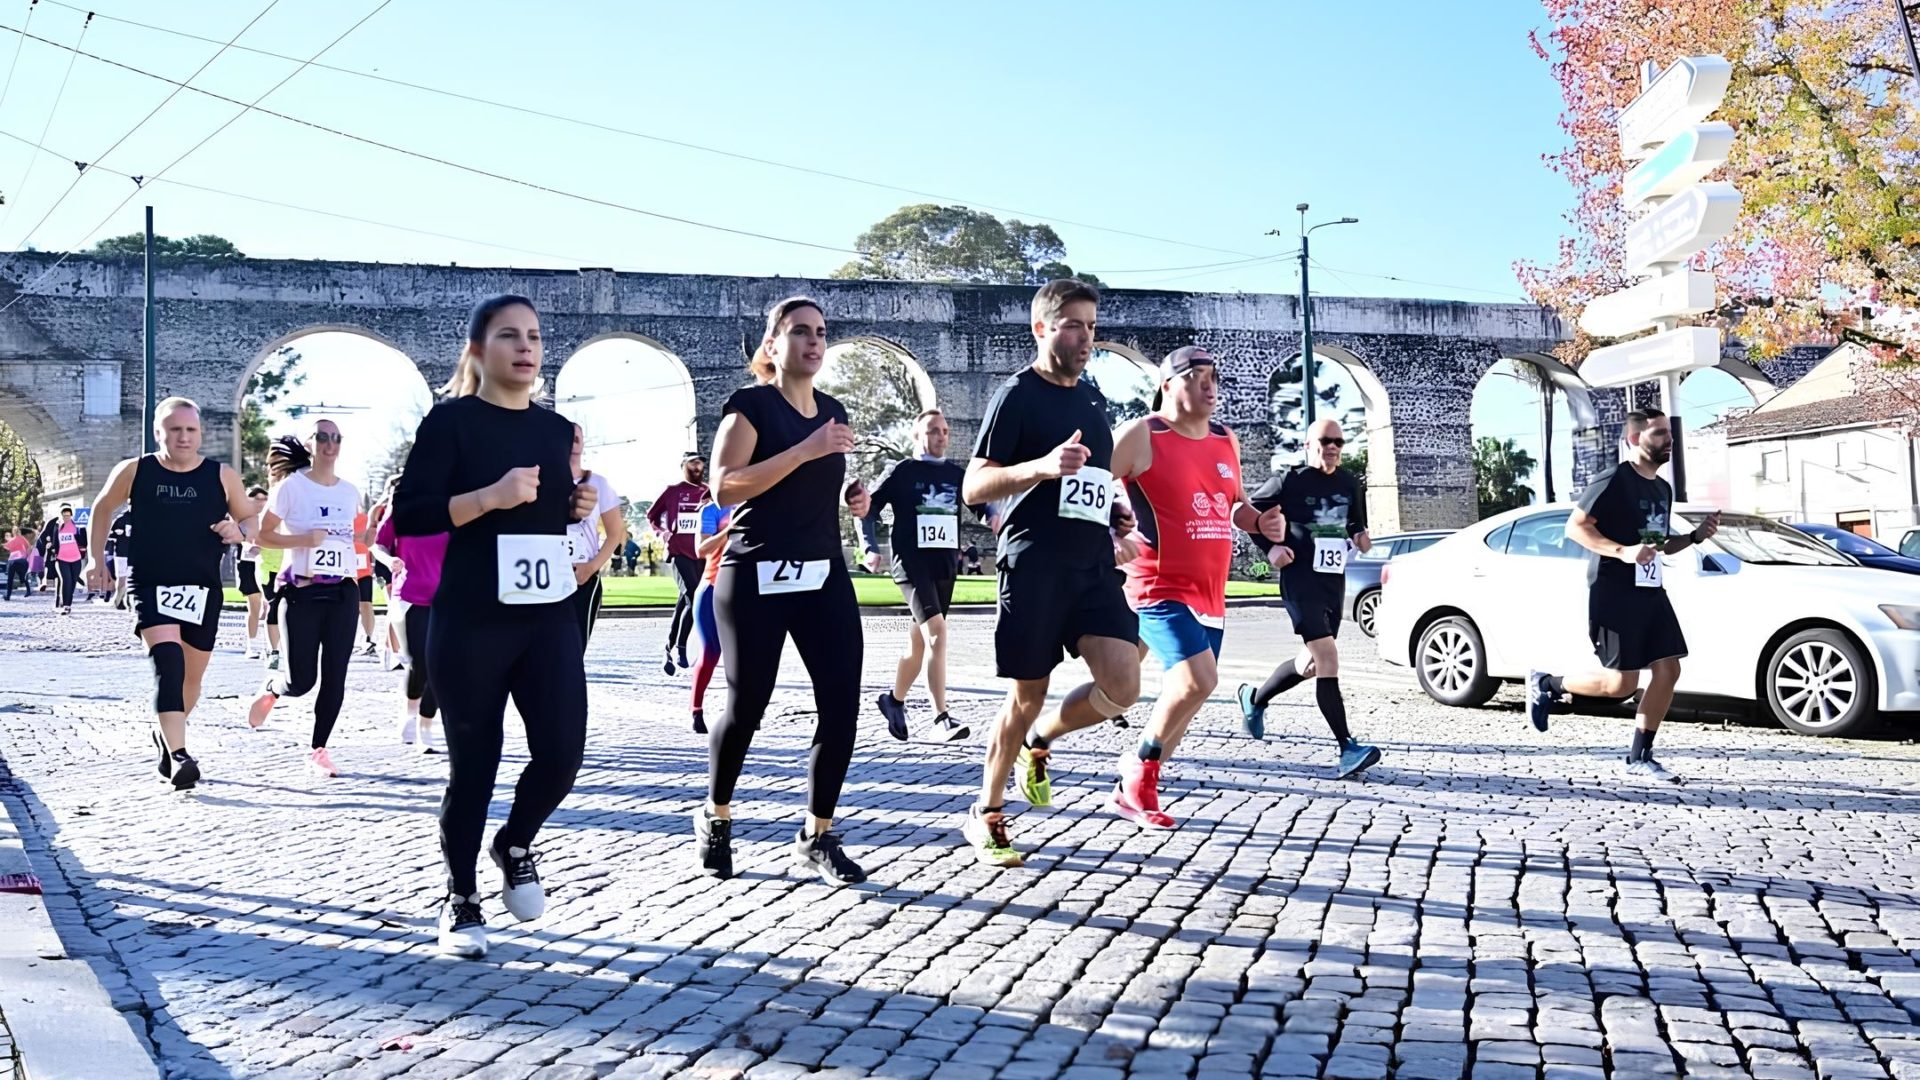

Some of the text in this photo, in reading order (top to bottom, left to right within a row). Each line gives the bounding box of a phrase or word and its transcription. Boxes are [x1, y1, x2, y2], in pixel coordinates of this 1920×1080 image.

[1066, 479, 1105, 509] 258
[921, 526, 946, 542] 134
[315, 550, 342, 568] 231
[1320, 550, 1342, 567] 133
[515, 559, 550, 590] 30
[773, 560, 805, 582] 29
[1643, 562, 1656, 580] 92
[161, 591, 197, 612] 224
